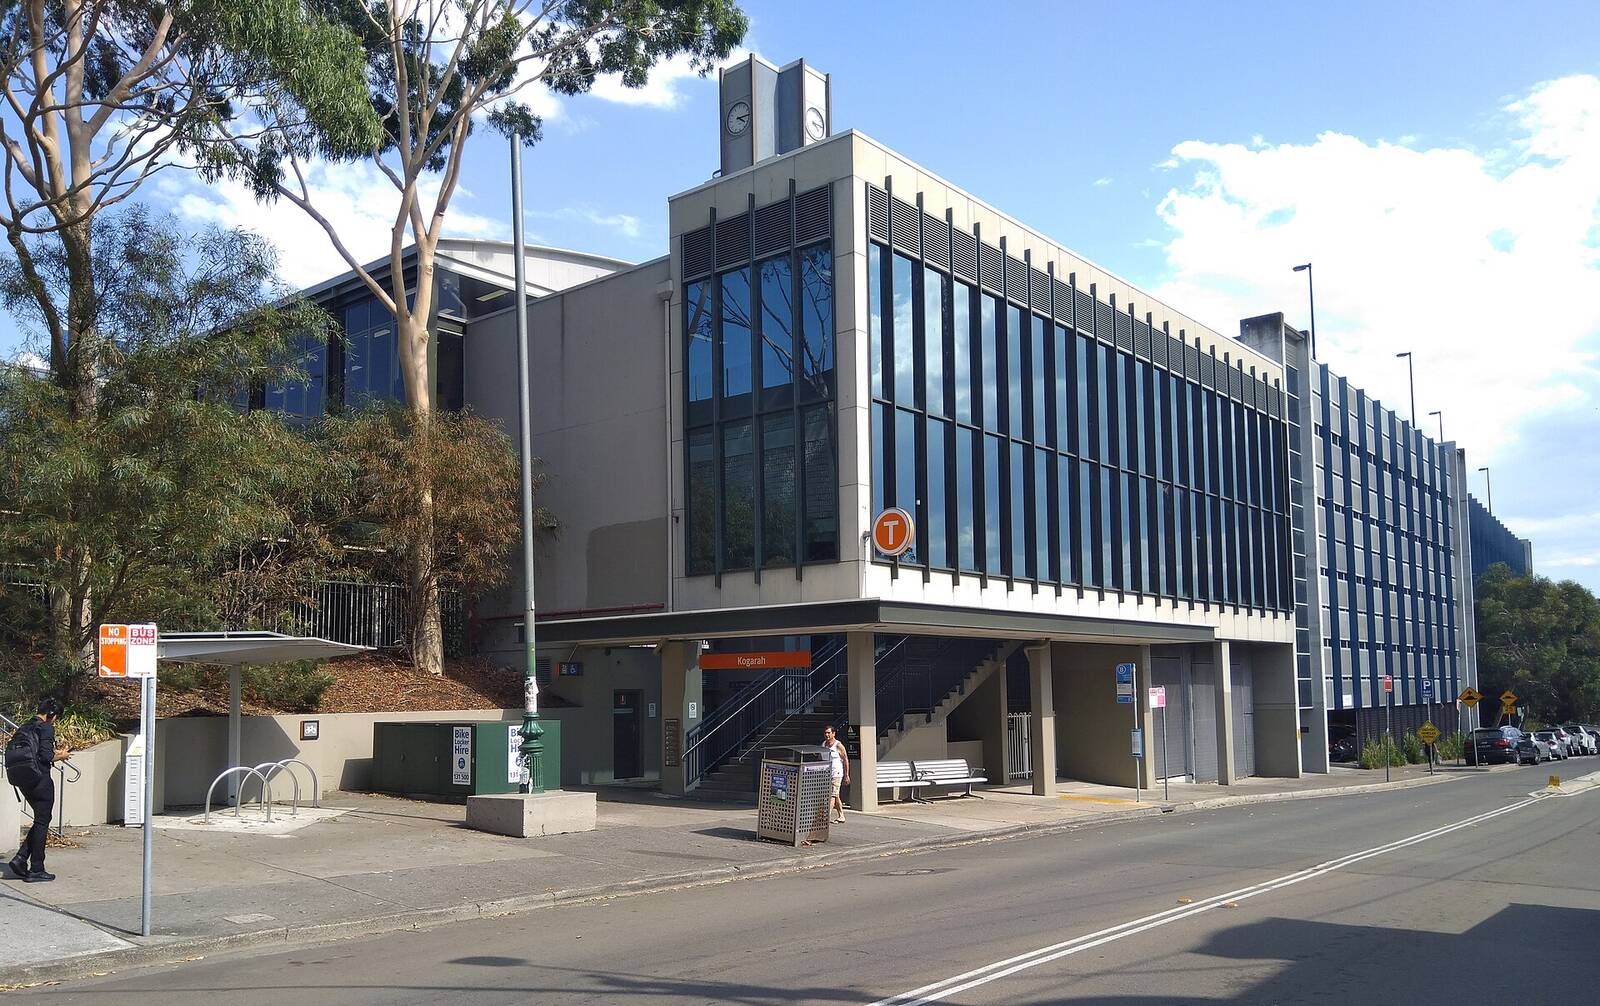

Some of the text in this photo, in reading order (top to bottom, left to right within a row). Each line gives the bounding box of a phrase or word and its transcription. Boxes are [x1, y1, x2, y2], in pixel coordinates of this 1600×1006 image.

[884, 520, 899, 545] T
[108, 627, 120, 636] NO
[132, 629, 154, 637] BUS
[100, 637, 127, 645] STOPPING
[737, 656, 766, 667] Kogarah
[1423, 680, 1431, 689] P
[455, 729, 469, 738] Bike
[455, 745, 469, 754] Hire
